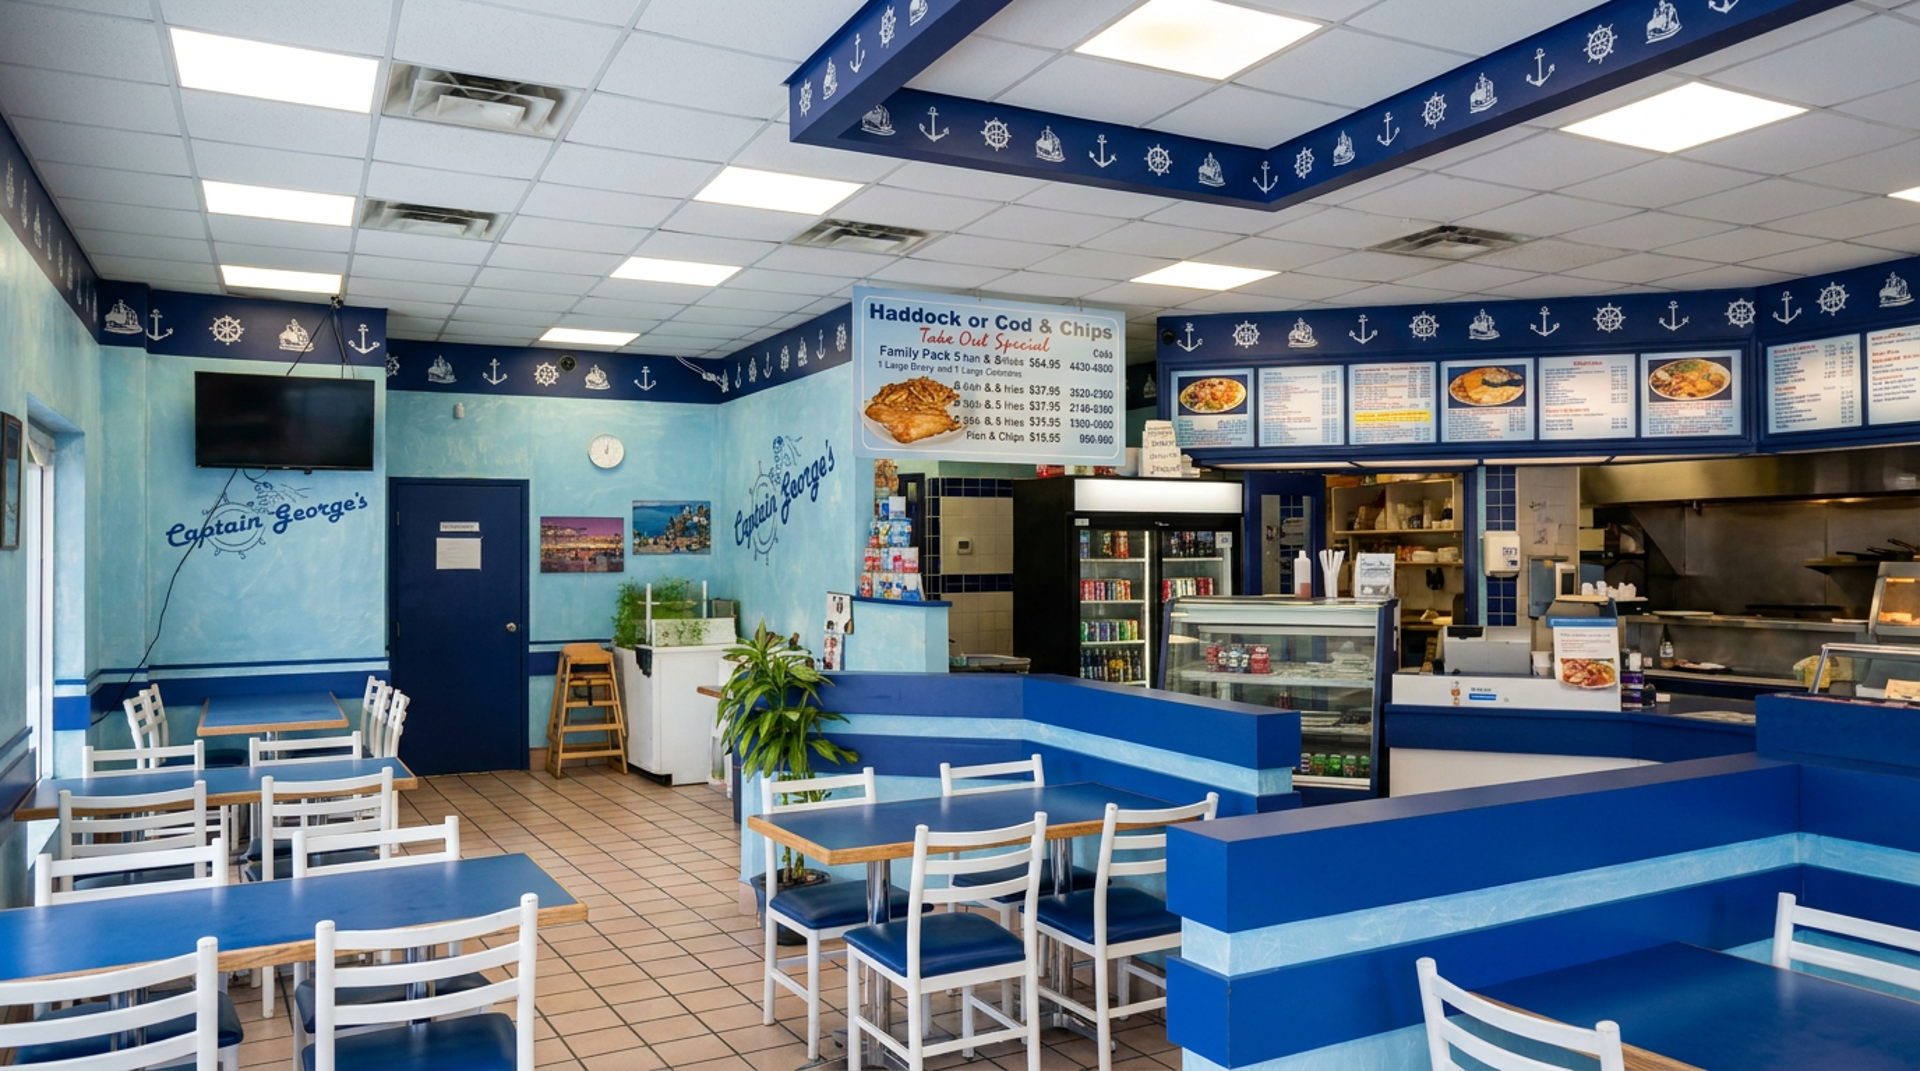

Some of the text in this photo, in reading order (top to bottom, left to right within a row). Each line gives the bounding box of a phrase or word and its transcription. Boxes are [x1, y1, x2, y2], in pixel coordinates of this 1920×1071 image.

[870, 303, 1113, 342] Haddock or Cod & Chips
[880, 345, 919, 361] Family
[922, 348, 951, 361] Pack
[983, 354, 991, 364] &
[885, 361, 909, 372] Large
[937, 365, 953, 374] and
[955, 366, 959, 374] 1
[1029, 385, 1061, 397] $37.95
[1029, 401, 1061, 413] $37.95
[989, 432, 996, 441] &
[734, 439, 835, 549] Captain George's
[165, 492, 368, 549] Captain George's
